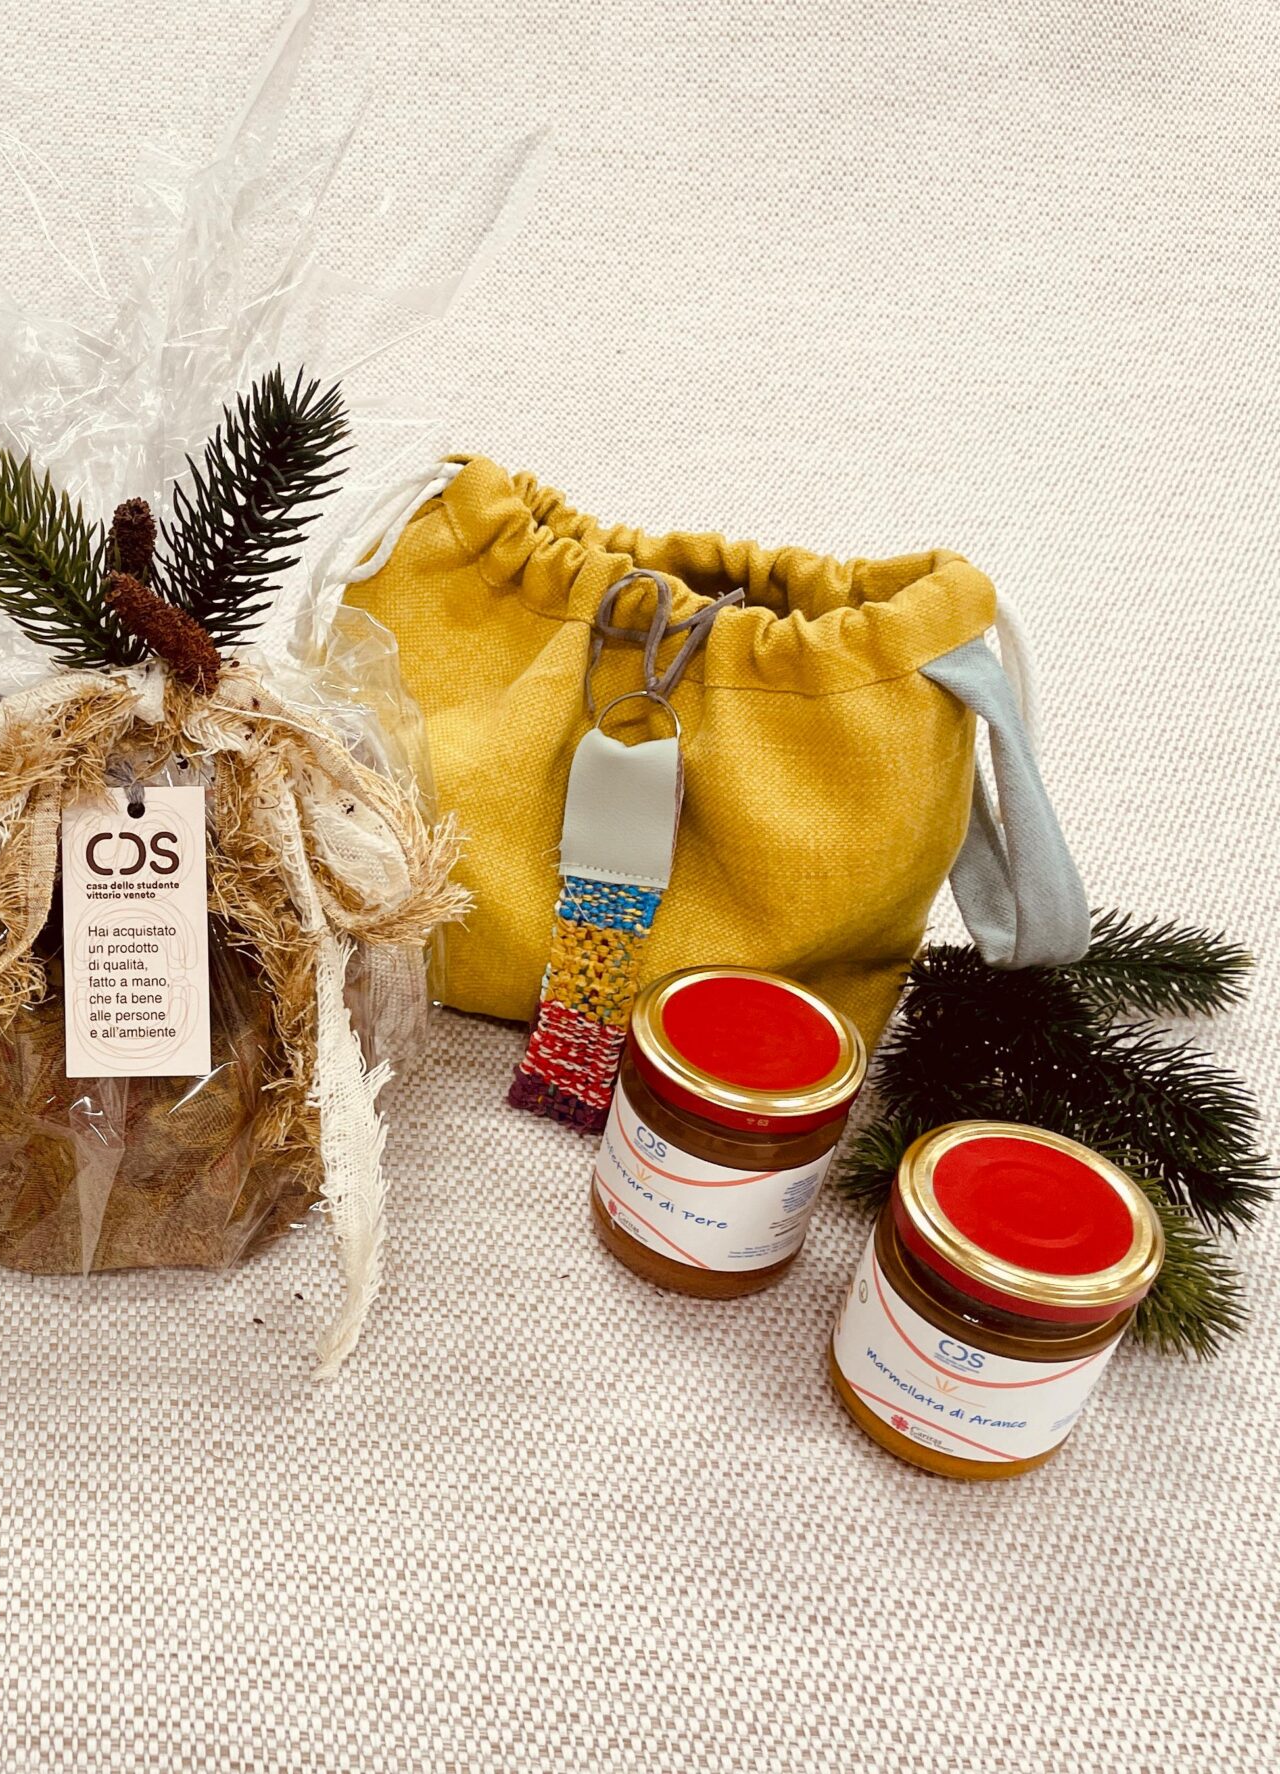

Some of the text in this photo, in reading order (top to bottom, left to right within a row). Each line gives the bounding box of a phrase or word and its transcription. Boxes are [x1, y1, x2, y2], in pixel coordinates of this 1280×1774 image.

[109, 880, 135, 890] dello
[136, 880, 180, 890] studente
[85, 890, 156, 900] vittorio veneto
[87, 924, 177, 939] Hai acquistato
[88, 941, 159, 957] un prodotto
[88, 957, 148, 973] di qualità,
[88, 975, 170, 988] fatto a mano,
[88, 992, 163, 1005] che fa bene
[89, 1009, 166, 1024] alle persone
[89, 1029, 98, 1039] e
[659, 1201, 674, 1213] di
[682, 1210, 728, 1229] Pere
[867, 1347, 945, 1412] Marmellata
[949, 1408, 965, 1420] di
